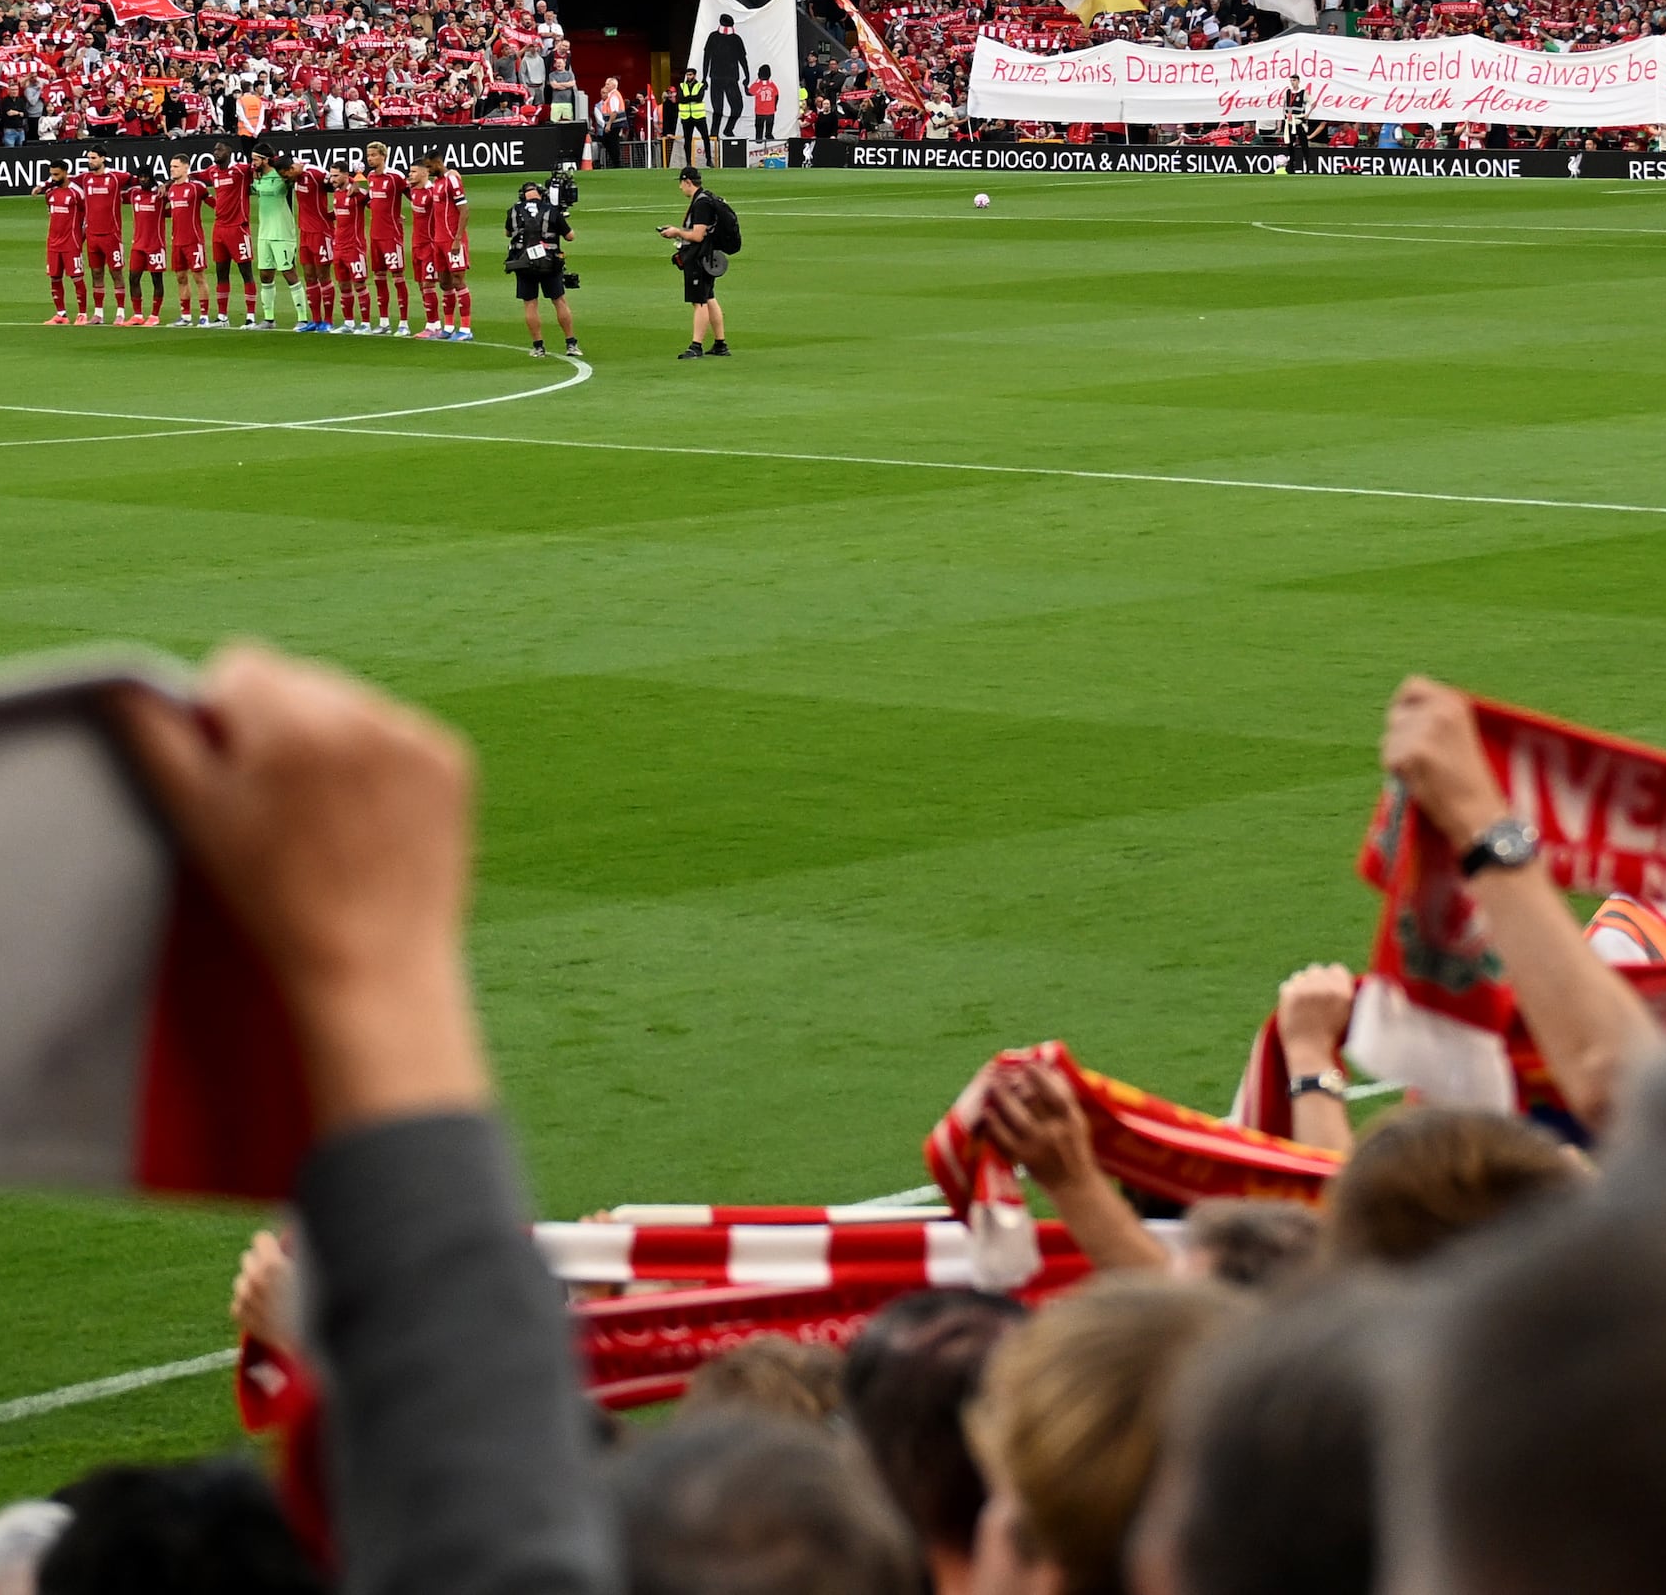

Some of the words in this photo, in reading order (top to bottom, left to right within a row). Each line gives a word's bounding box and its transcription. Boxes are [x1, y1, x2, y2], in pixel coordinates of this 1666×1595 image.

[991, 56, 1049, 86] Rute,
[1057, 59, 1117, 87] Dinis,
[1126, 55, 1219, 88] Duarte,
[1230, 48, 1333, 82] Mafalda
[1368, 49, 1460, 82] Anfield
[1471, 52, 1517, 84] will
[1527, 59, 1617, 94] always
[1627, 53, 1656, 81] be
[1384, 84, 1455, 114] Walk
[1461, 86, 1550, 114] Alone
[443, 140, 525, 173] ALONE
[853, 146, 900, 166] REST
[902, 148, 921, 166] IN
[924, 148, 983, 168] PEACE
[986, 149, 1047, 170] DIOGO
[1049, 151, 1096, 171] JOTA
[1099, 152, 1113, 171] &
[1116, 148, 1182, 174] ANDRÉ
[1317, 155, 1385, 175] NEVER
[1390, 155, 1446, 178] WALK
[1449, 157, 1521, 178] ALONE
[238, 242, 247, 255] 5
[282, 249, 289, 261] 1
[318, 245, 328, 257] 4
[112, 250, 120, 261] 8
[148, 254, 162, 265] 30
[192, 251, 200, 263] 7
[384, 251, 397, 265] 22
[350, 261, 362, 274] 10
[426, 263, 434, 274] 6
